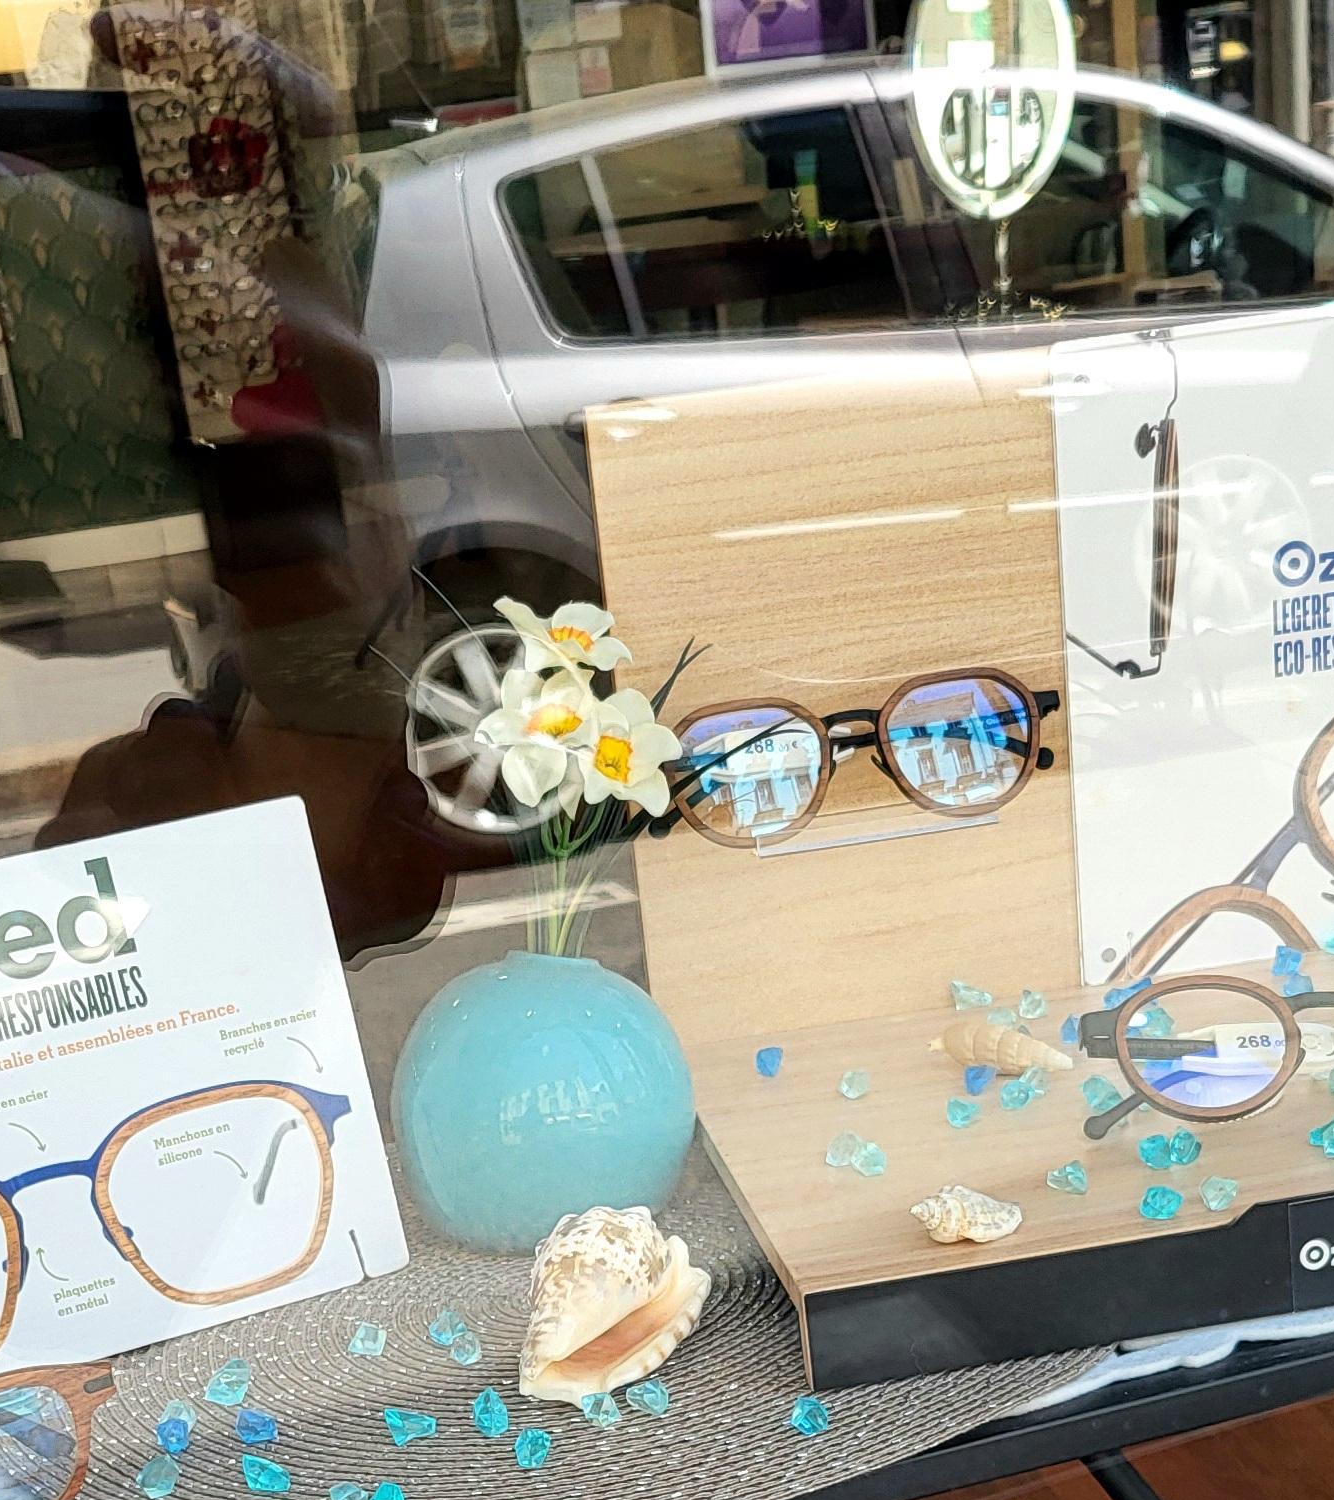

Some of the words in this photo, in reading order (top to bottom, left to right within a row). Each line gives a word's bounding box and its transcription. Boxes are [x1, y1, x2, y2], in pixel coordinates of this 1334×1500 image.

[37, 1044, 54, 1062] et
[57, 1024, 154, 1057] assemblées
[156, 1018, 178, 1032] en
[179, 1003, 241, 1027] France.
[219, 1020, 273, 1041] Branches
[274, 1016, 288, 1028] en
[289, 1008, 317, 1024] acier
[223, 1037, 265, 1058] recyclé
[0, 1096, 17, 1110] en
[18, 1088, 49, 1105] acier
[153, 1125, 215, 1151] Manchons
[216, 1122, 231, 1134] en
[158, 1147, 203, 1167] silicone
[53, 1277, 116, 1303] plaquettes
[57, 1305, 74, 1317] en
[75, 1293, 109, 1313] métal
